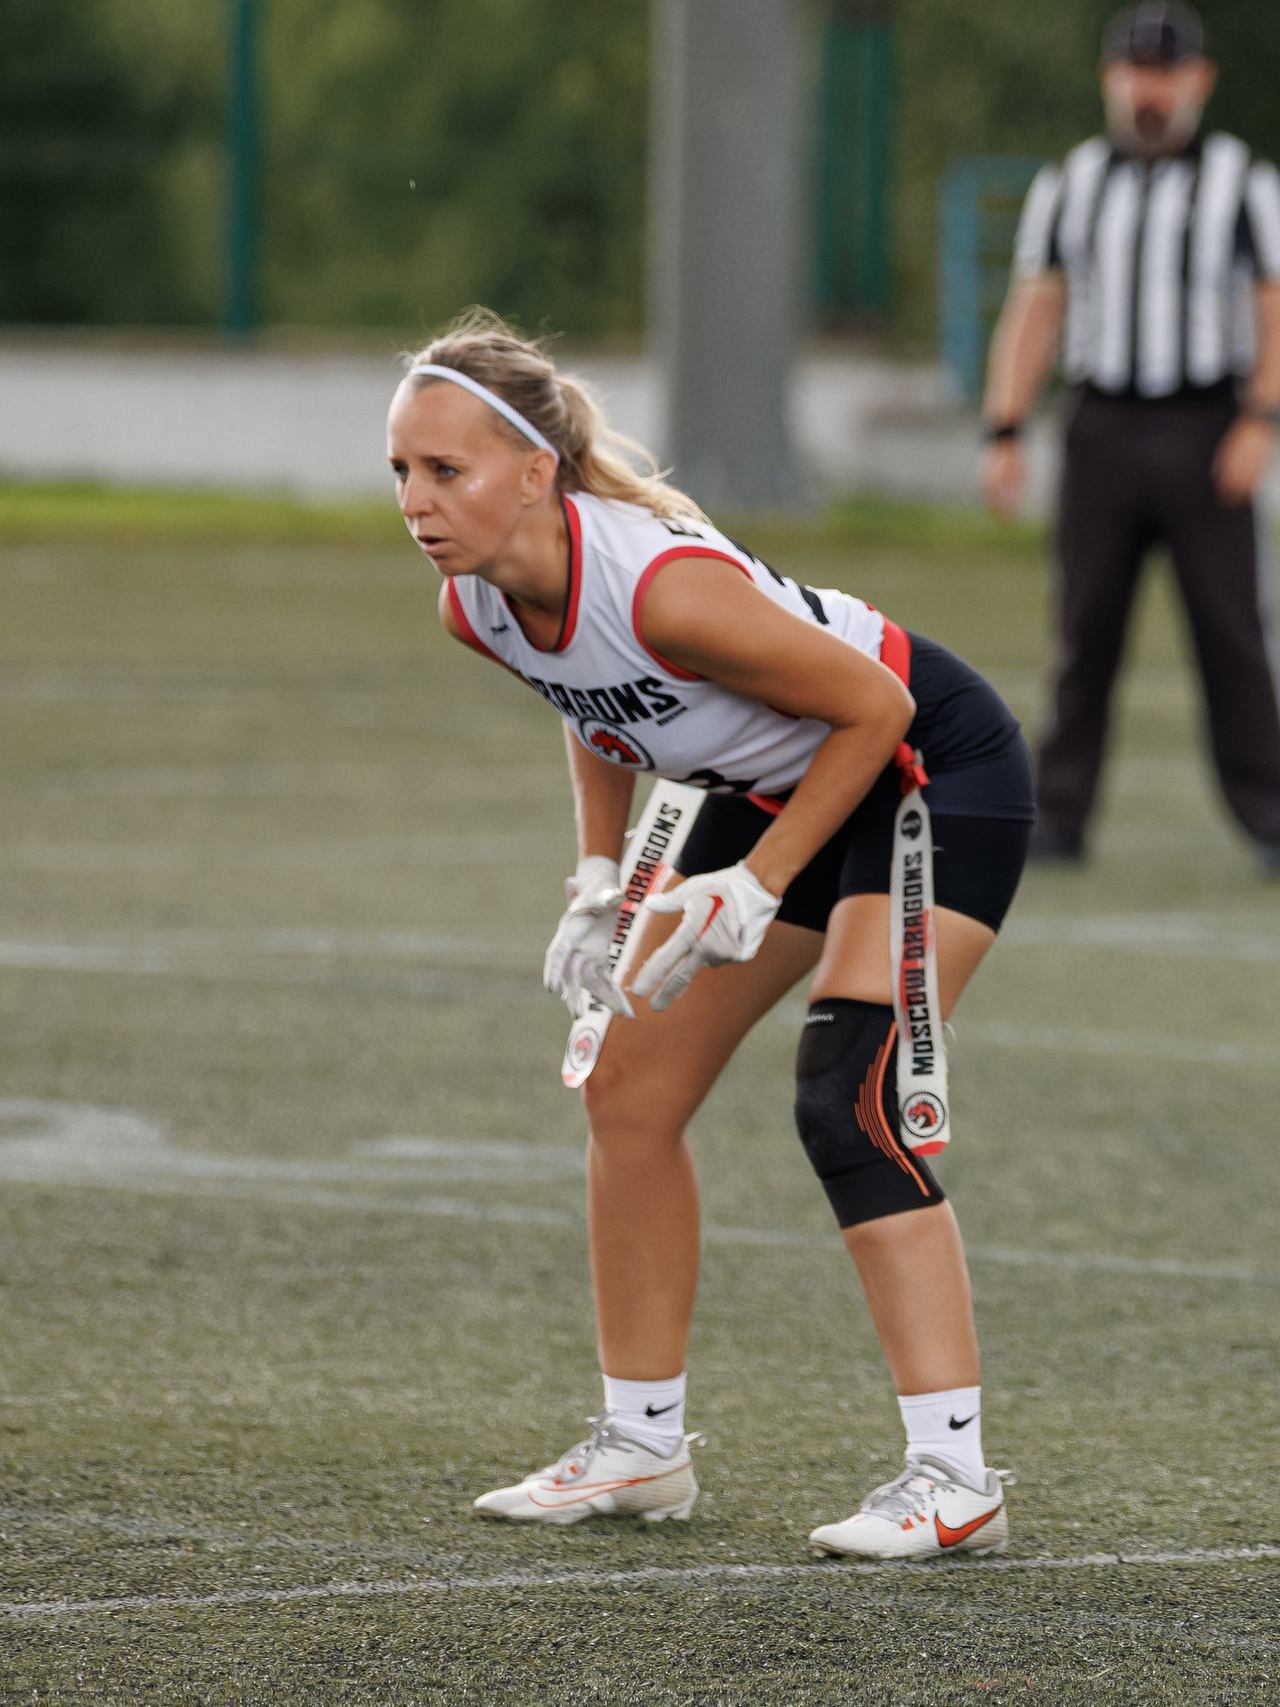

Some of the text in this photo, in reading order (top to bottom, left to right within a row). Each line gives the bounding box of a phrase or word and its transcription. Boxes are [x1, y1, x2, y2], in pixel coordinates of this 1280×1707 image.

[625, 803, 682, 903] DRAGONS
[904, 850, 925, 960] DRAGONS
[904, 968, 934, 1076] MOSCOW
